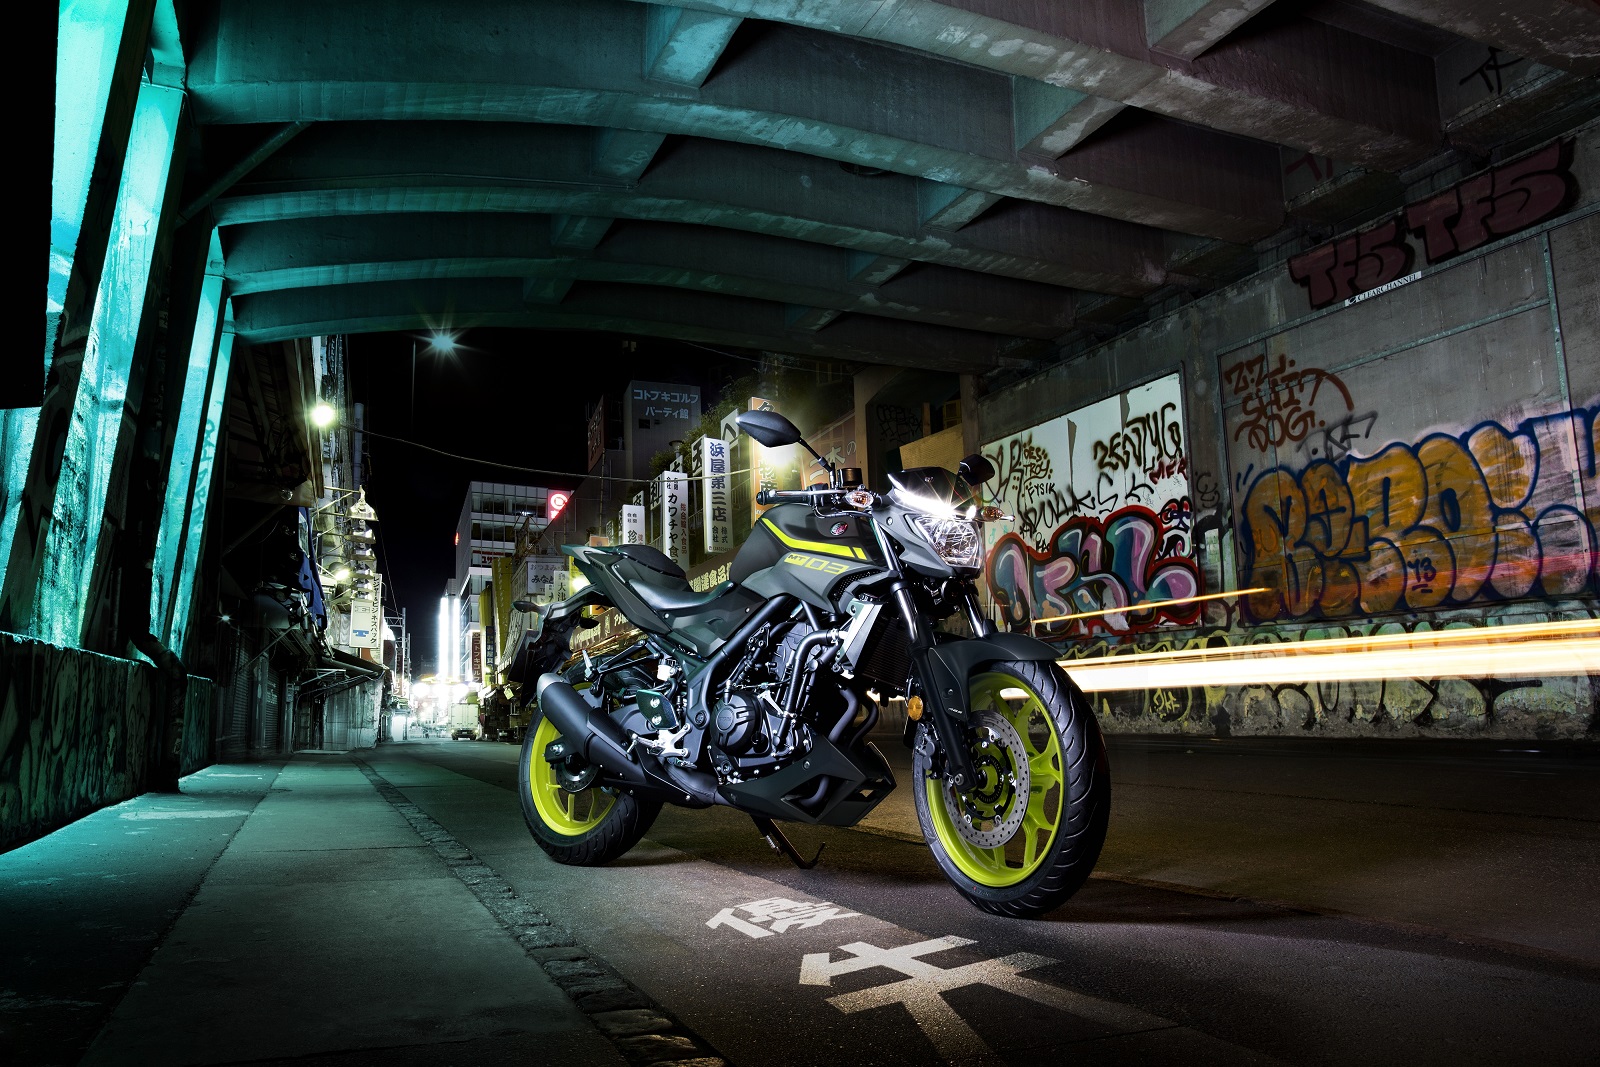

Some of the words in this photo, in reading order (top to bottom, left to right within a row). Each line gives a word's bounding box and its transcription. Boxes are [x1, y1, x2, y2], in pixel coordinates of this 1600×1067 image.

[633, 389, 699, 404] コトブキゴルフ
[645, 406, 689, 419] パーティ館
[710, 442, 727, 522] 浜屋第三店
[668, 492, 679, 563] カワチヤ食
